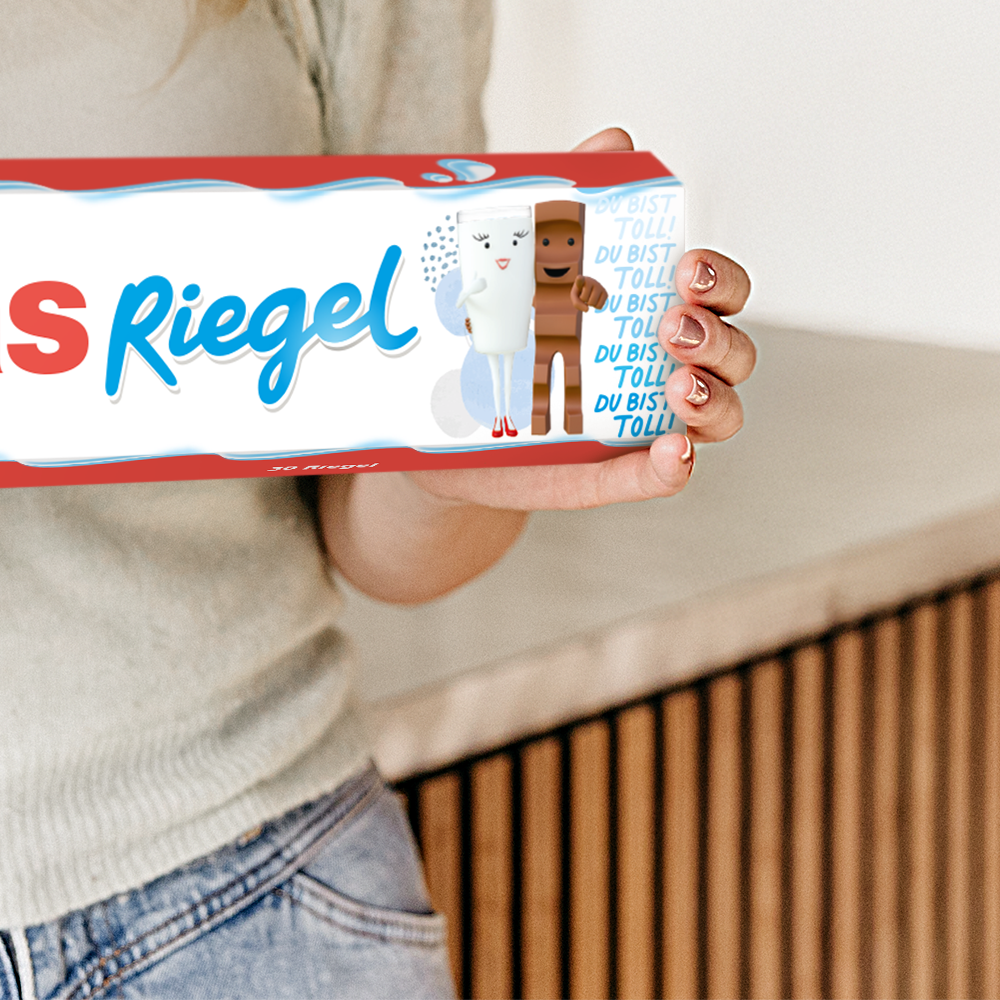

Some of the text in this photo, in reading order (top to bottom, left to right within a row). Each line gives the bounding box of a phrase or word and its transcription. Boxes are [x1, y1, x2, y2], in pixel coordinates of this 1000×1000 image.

[594, 194, 677, 214] DU BIST
[614, 215, 676, 240] TOLL!
[594, 243, 677, 264] DU BIST
[614, 264, 676, 289] TOLL!
[626, 292, 677, 313] BIST
[104, 244, 419, 407] Riegel
[594, 343, 623, 363] DU
[594, 393, 622, 412] DU
[613, 412, 676, 438] TOLL!
[302, 462, 380, 471] Riegel
